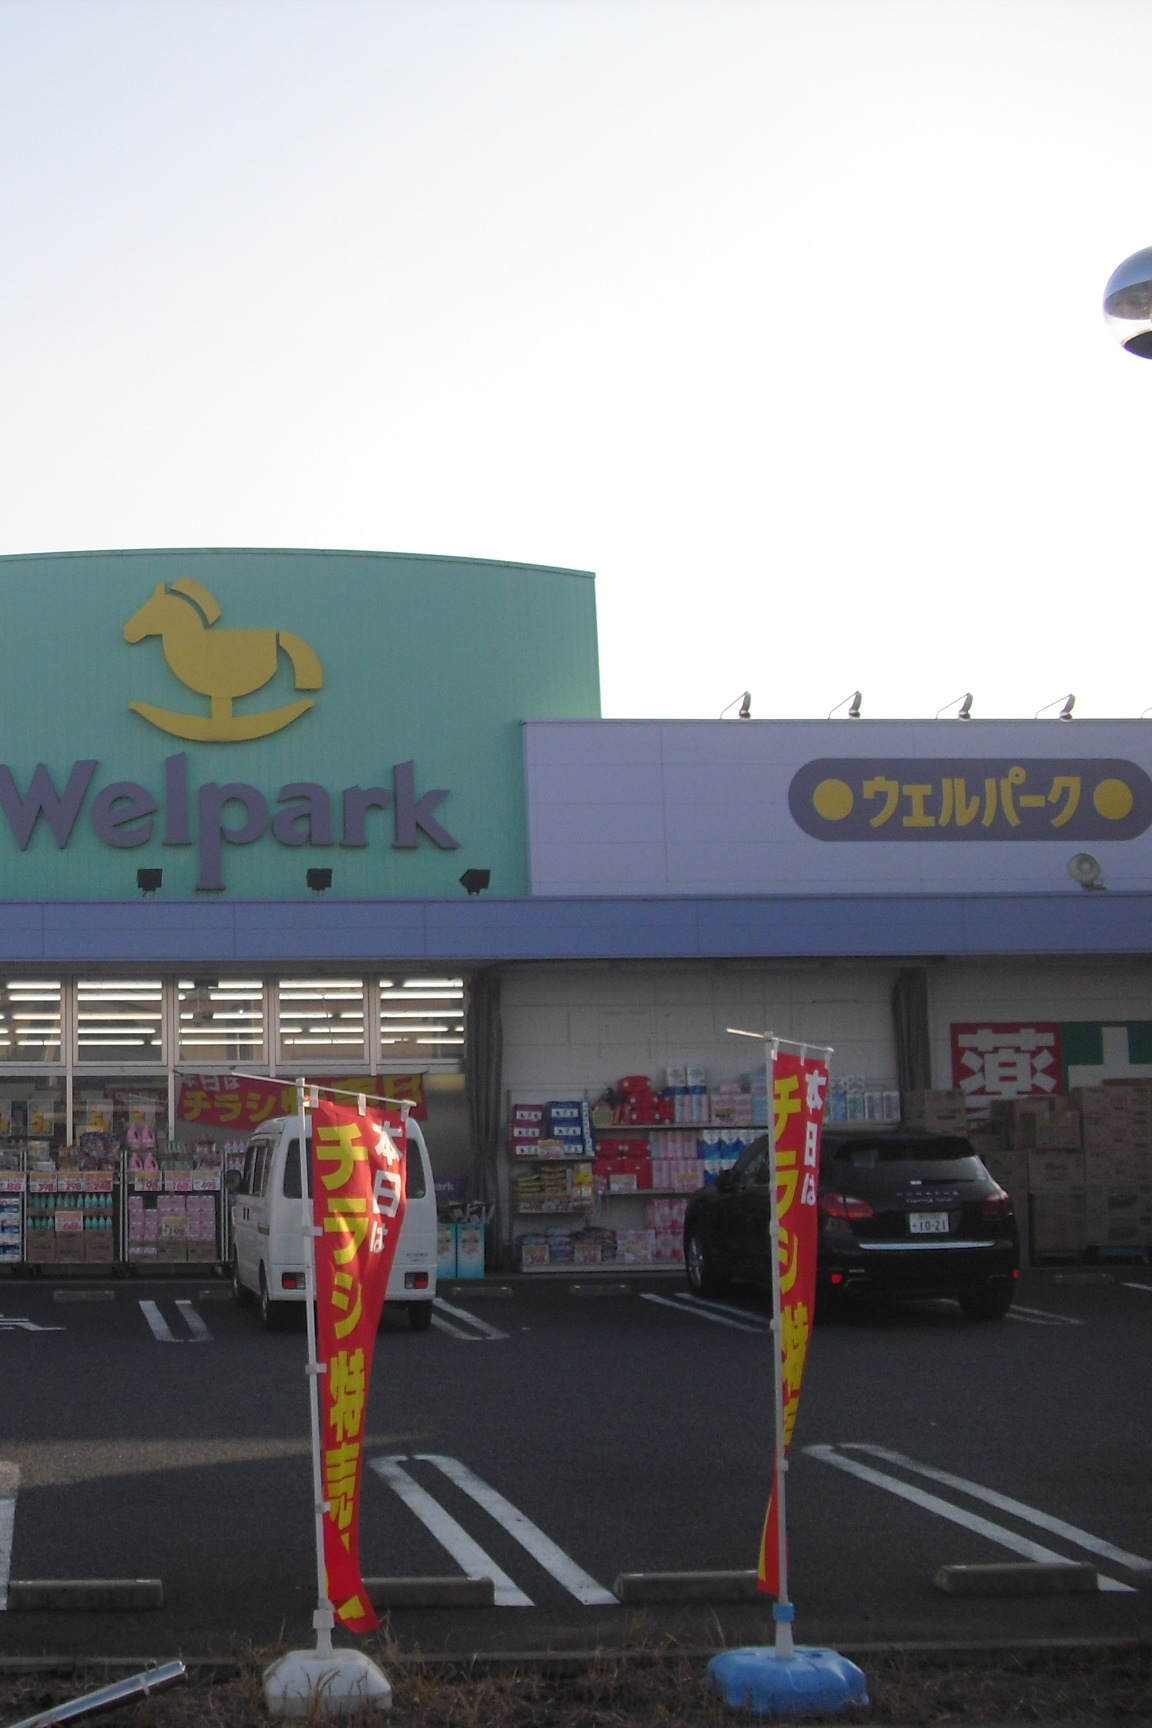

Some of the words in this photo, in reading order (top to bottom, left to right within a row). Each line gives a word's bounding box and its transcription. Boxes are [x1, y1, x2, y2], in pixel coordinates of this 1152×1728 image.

[800, 1069, 828, 1206] 本日は
[957, 1027, 1057, 1118] 薬
[371, 1120, 404, 1254] 本日は
